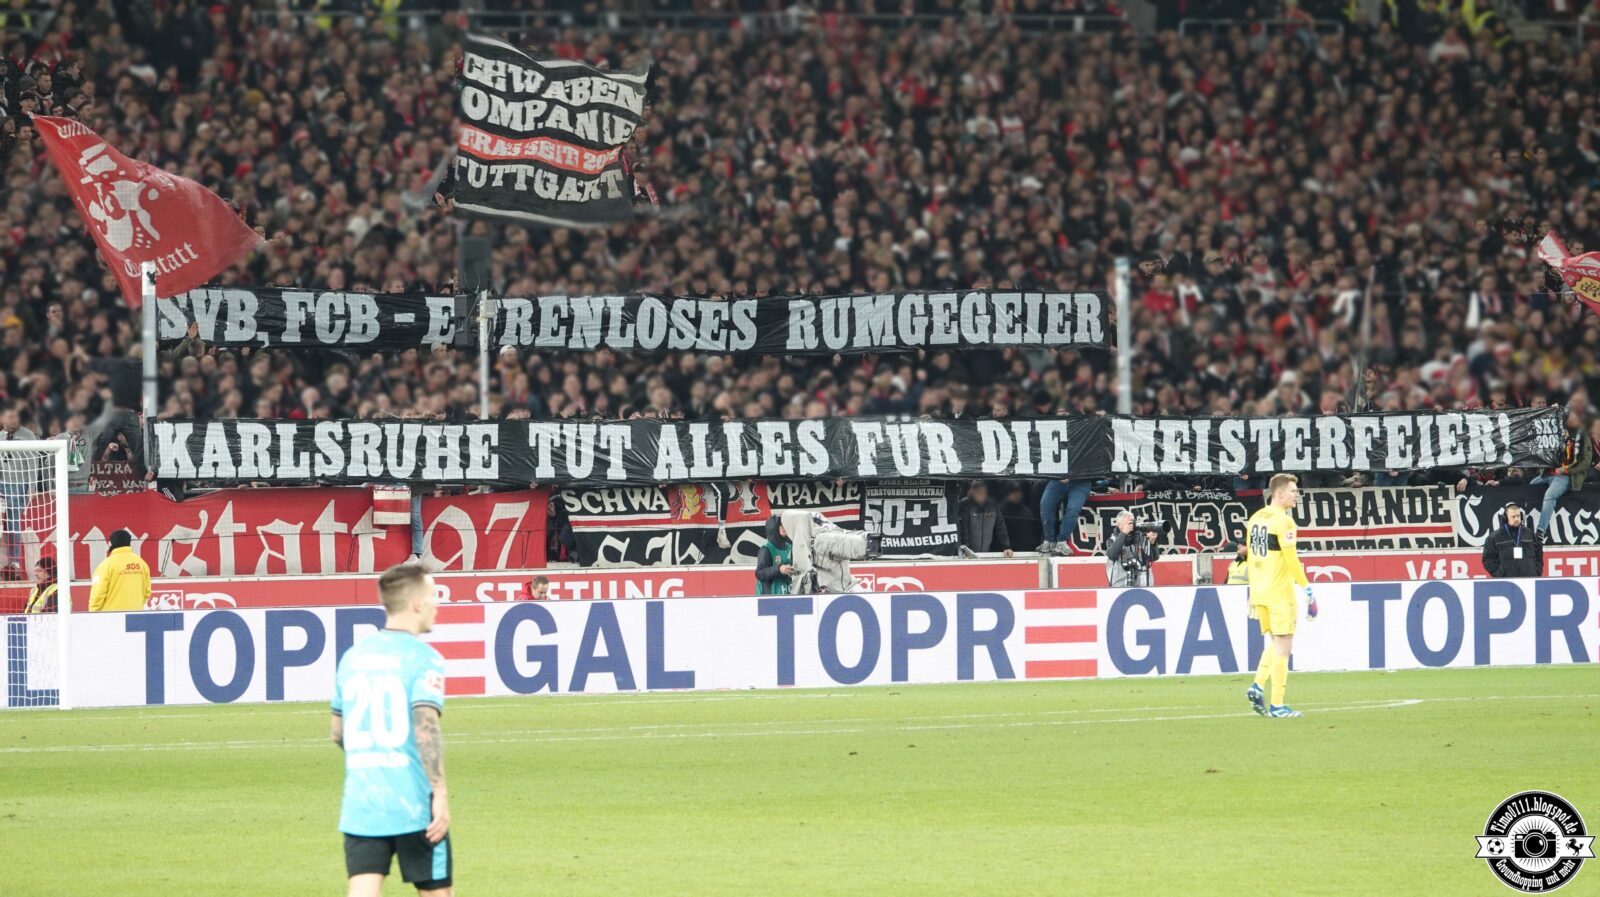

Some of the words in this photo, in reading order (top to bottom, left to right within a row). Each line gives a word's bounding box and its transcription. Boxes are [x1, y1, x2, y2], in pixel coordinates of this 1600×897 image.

[281, 291, 381, 345] FCB
[420, 294, 758, 351] ERENLOSES
[786, 292, 1104, 350] RUMGEGEIER
[154, 421, 499, 480] KARLSRUHE
[528, 422, 632, 480] TUT
[653, 420, 830, 479] ALLES
[851, 415, 962, 477] FÜR
[976, 420, 1069, 475] DIE
[1111, 413, 1512, 473] MEISTERFEIER!
[864, 498, 958, 537] 50+1
[1250, 524, 1268, 557] 33
[1351, 579, 1600, 670] TOPR
[342, 672, 410, 750] 20
